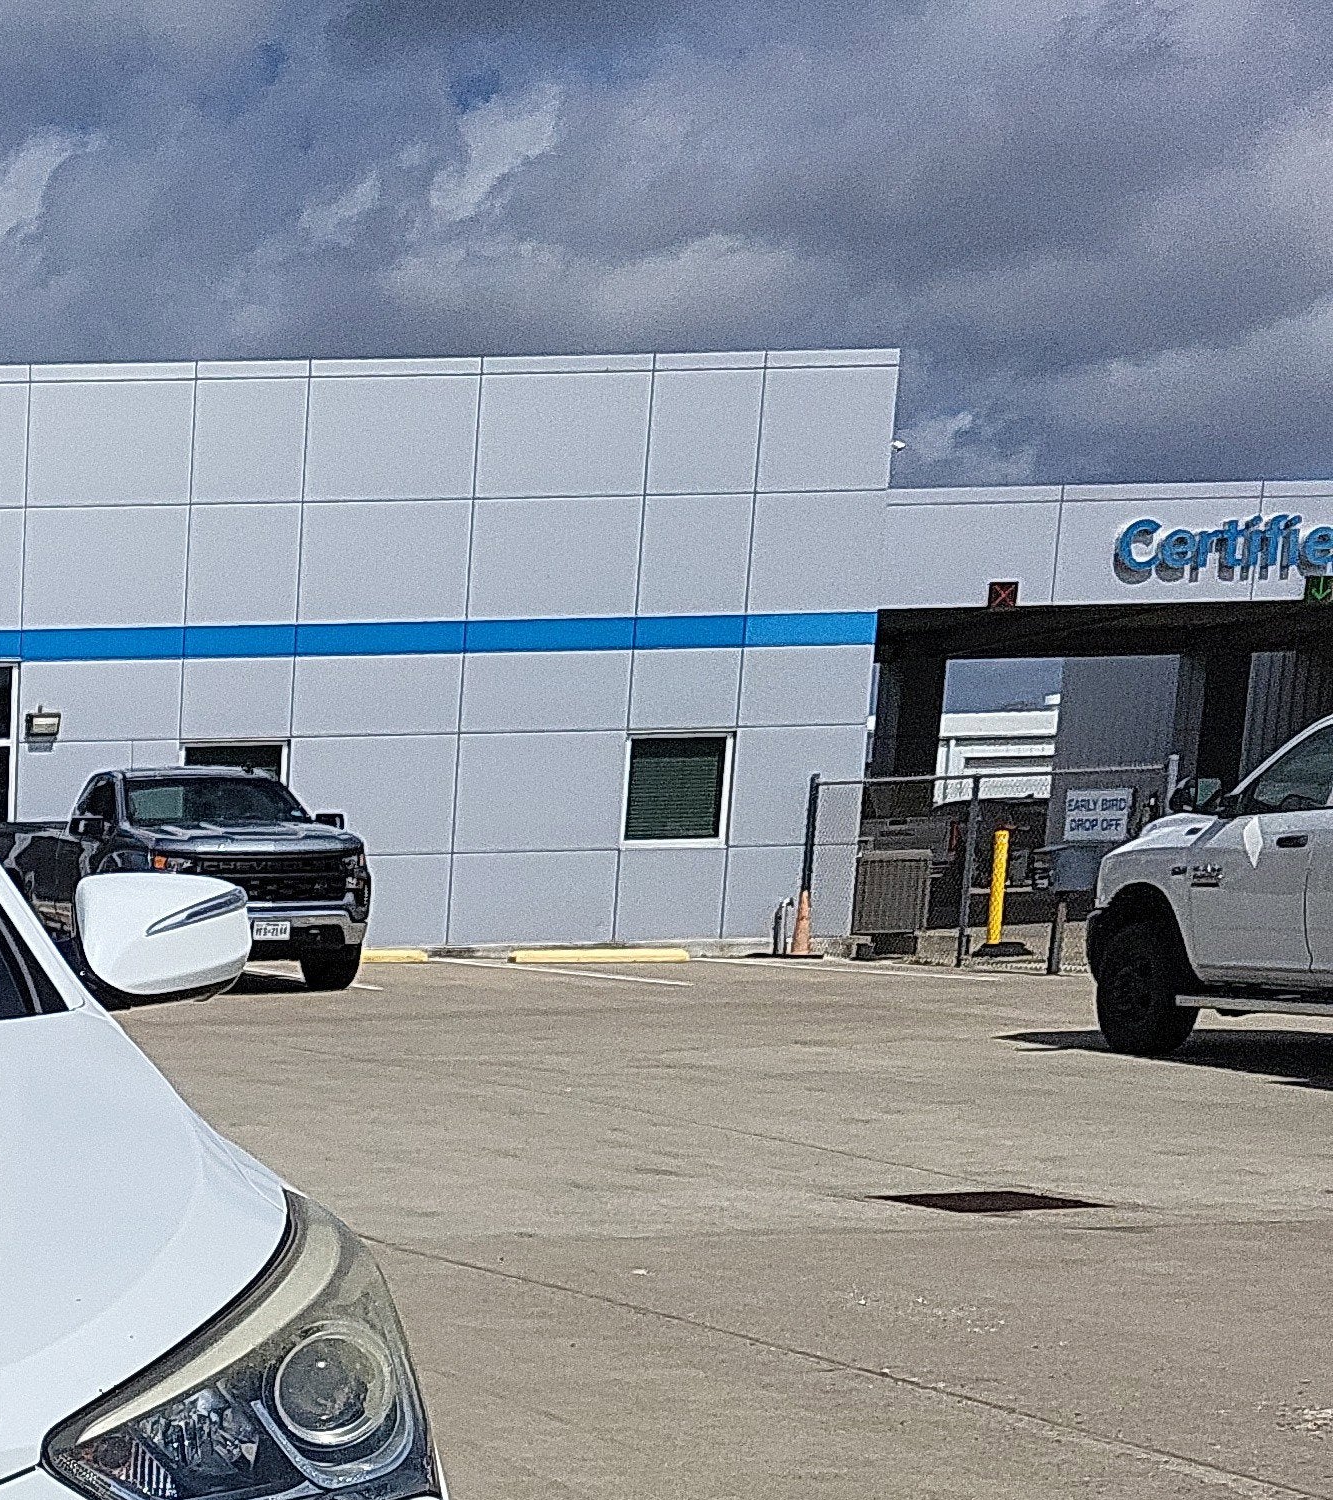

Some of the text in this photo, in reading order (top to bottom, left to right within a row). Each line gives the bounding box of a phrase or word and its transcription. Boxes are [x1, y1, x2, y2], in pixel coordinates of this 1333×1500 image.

[1117, 514, 1333, 572] Certifie
[1067, 797, 1127, 811] EARLY BIRD
[1070, 818, 1123, 831] DROP OFF
